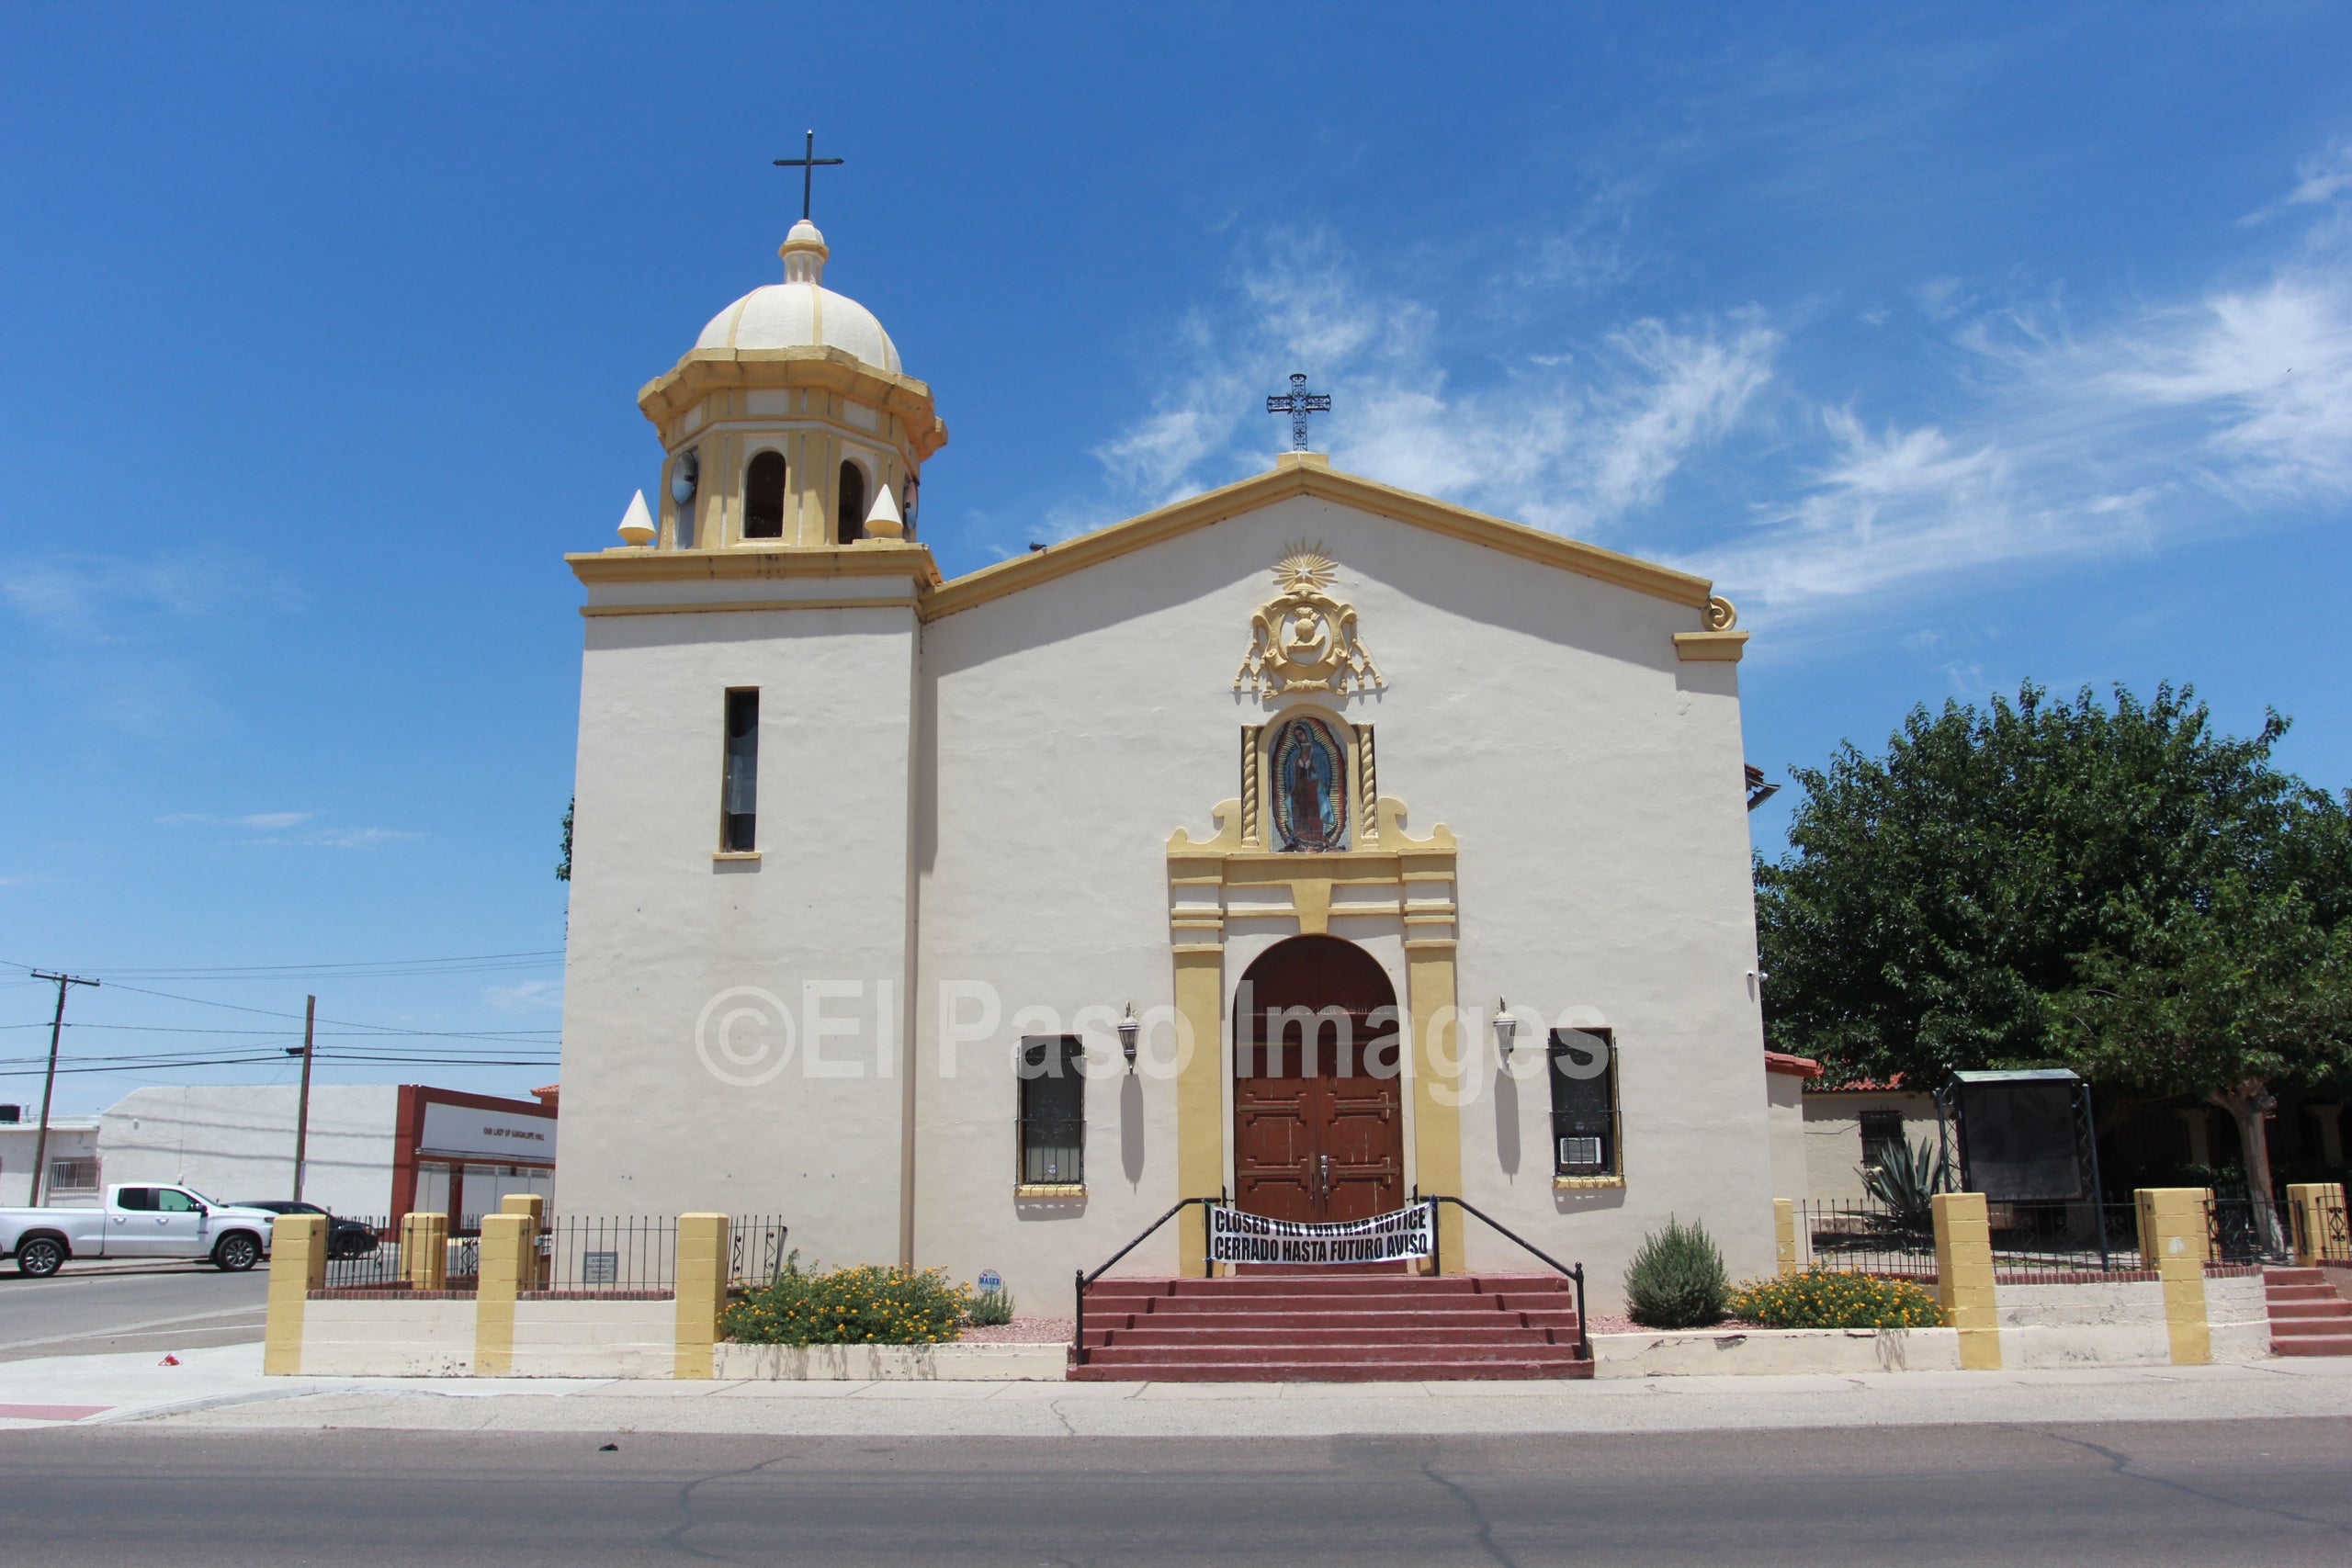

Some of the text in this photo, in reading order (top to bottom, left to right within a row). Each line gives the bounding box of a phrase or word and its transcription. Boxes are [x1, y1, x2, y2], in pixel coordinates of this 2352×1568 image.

[1215, 1207, 1427, 1238] CLOSED TILL FURTHER NOTICE
[1215, 1233, 1428, 1262] CERRADO HASTA FUTURO AVISO
